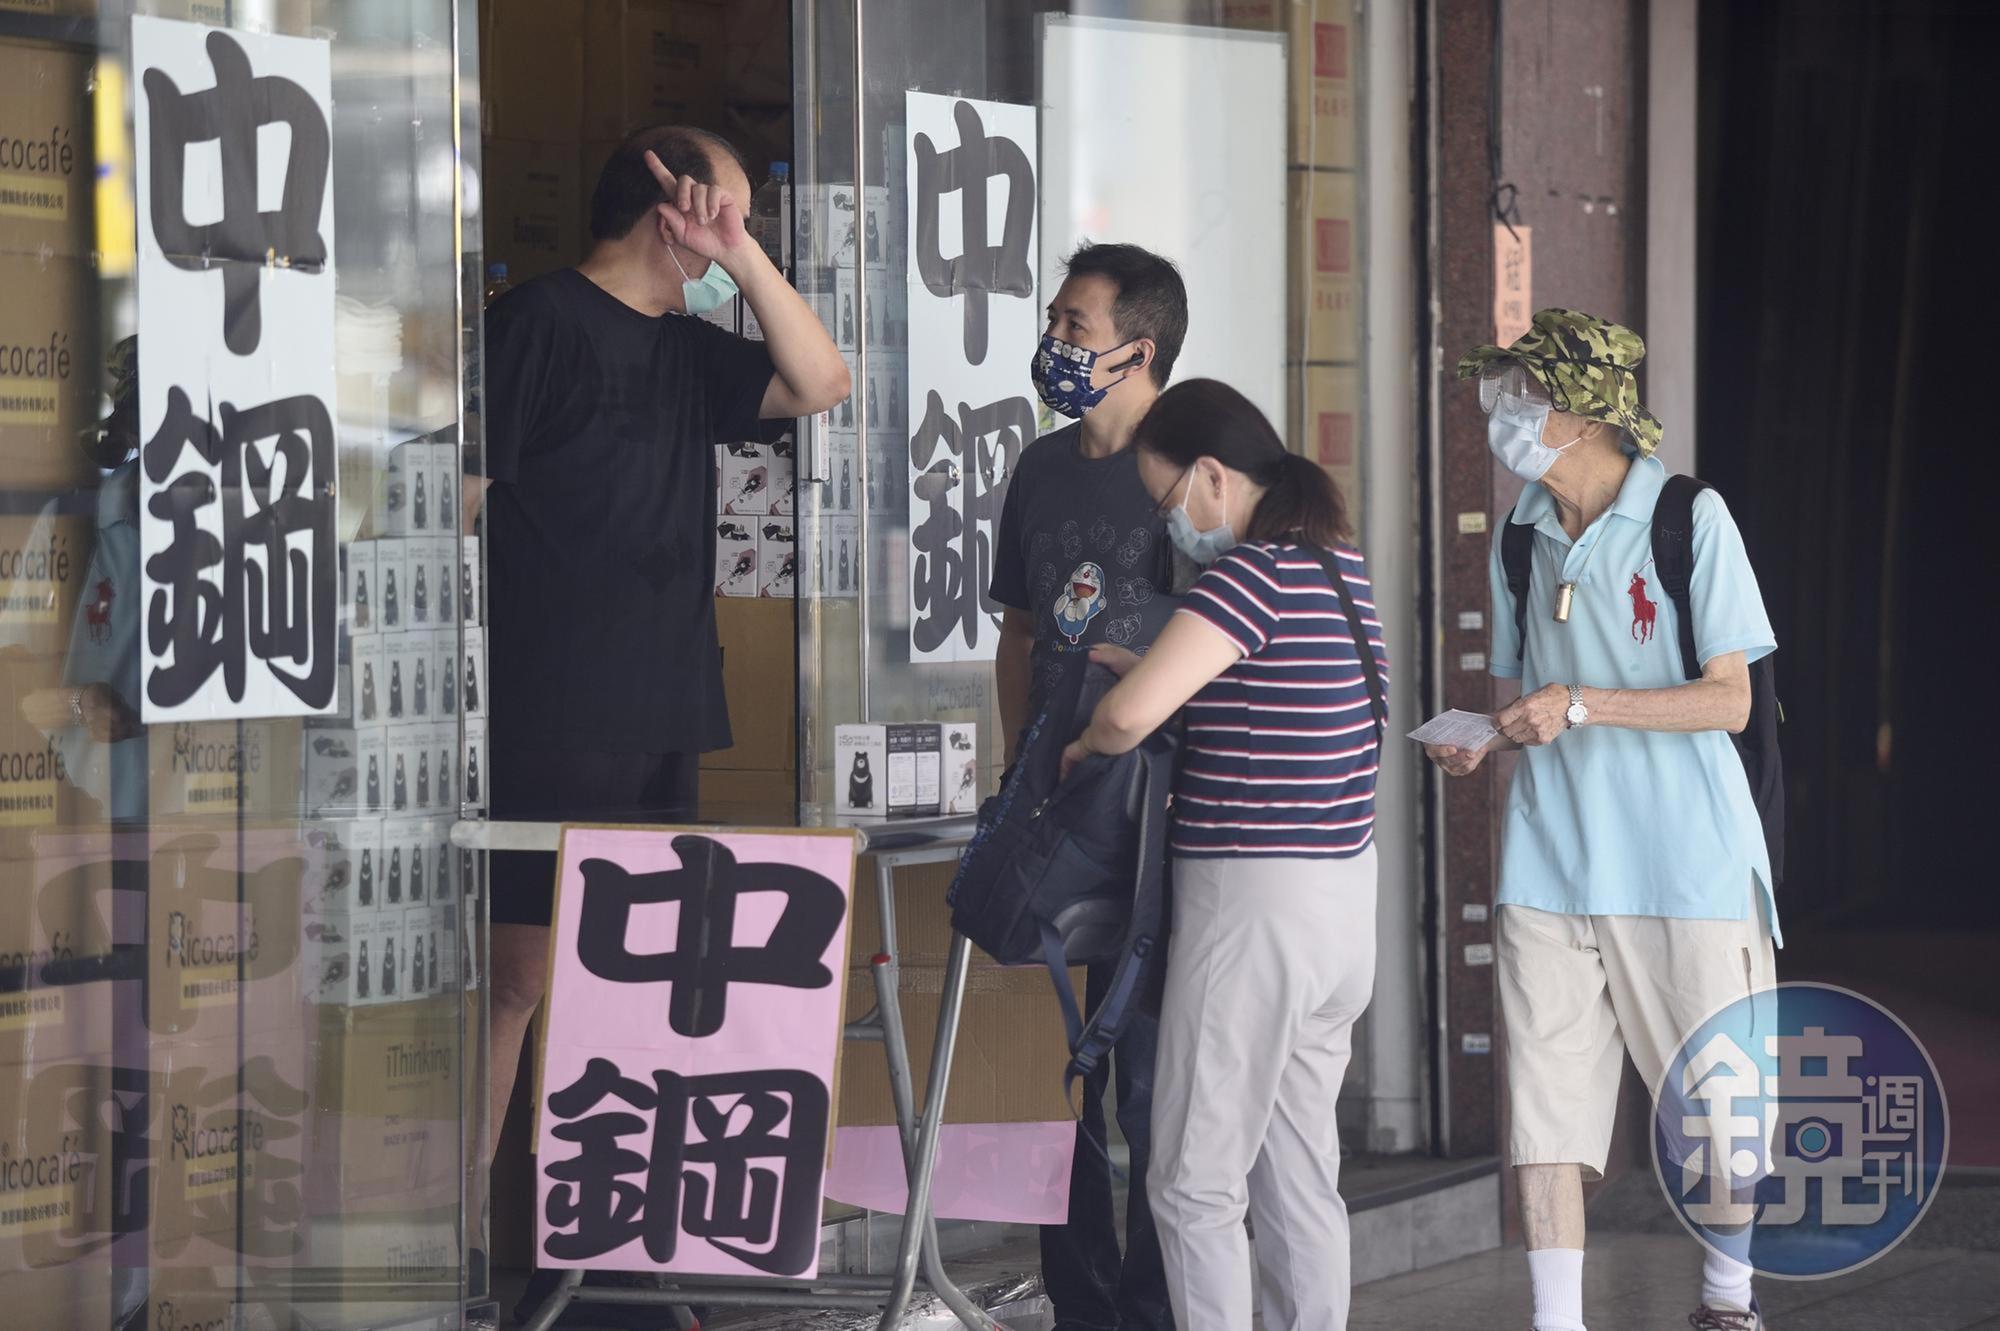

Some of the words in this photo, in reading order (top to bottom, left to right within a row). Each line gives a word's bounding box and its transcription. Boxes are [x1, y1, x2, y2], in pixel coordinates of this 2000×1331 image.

[143, 30, 336, 710] 中鋼
[910, 100, 1037, 653] 中鋼
[166, 911, 259, 968] Ricocaé
[544, 834, 847, 1276] 中鋼
